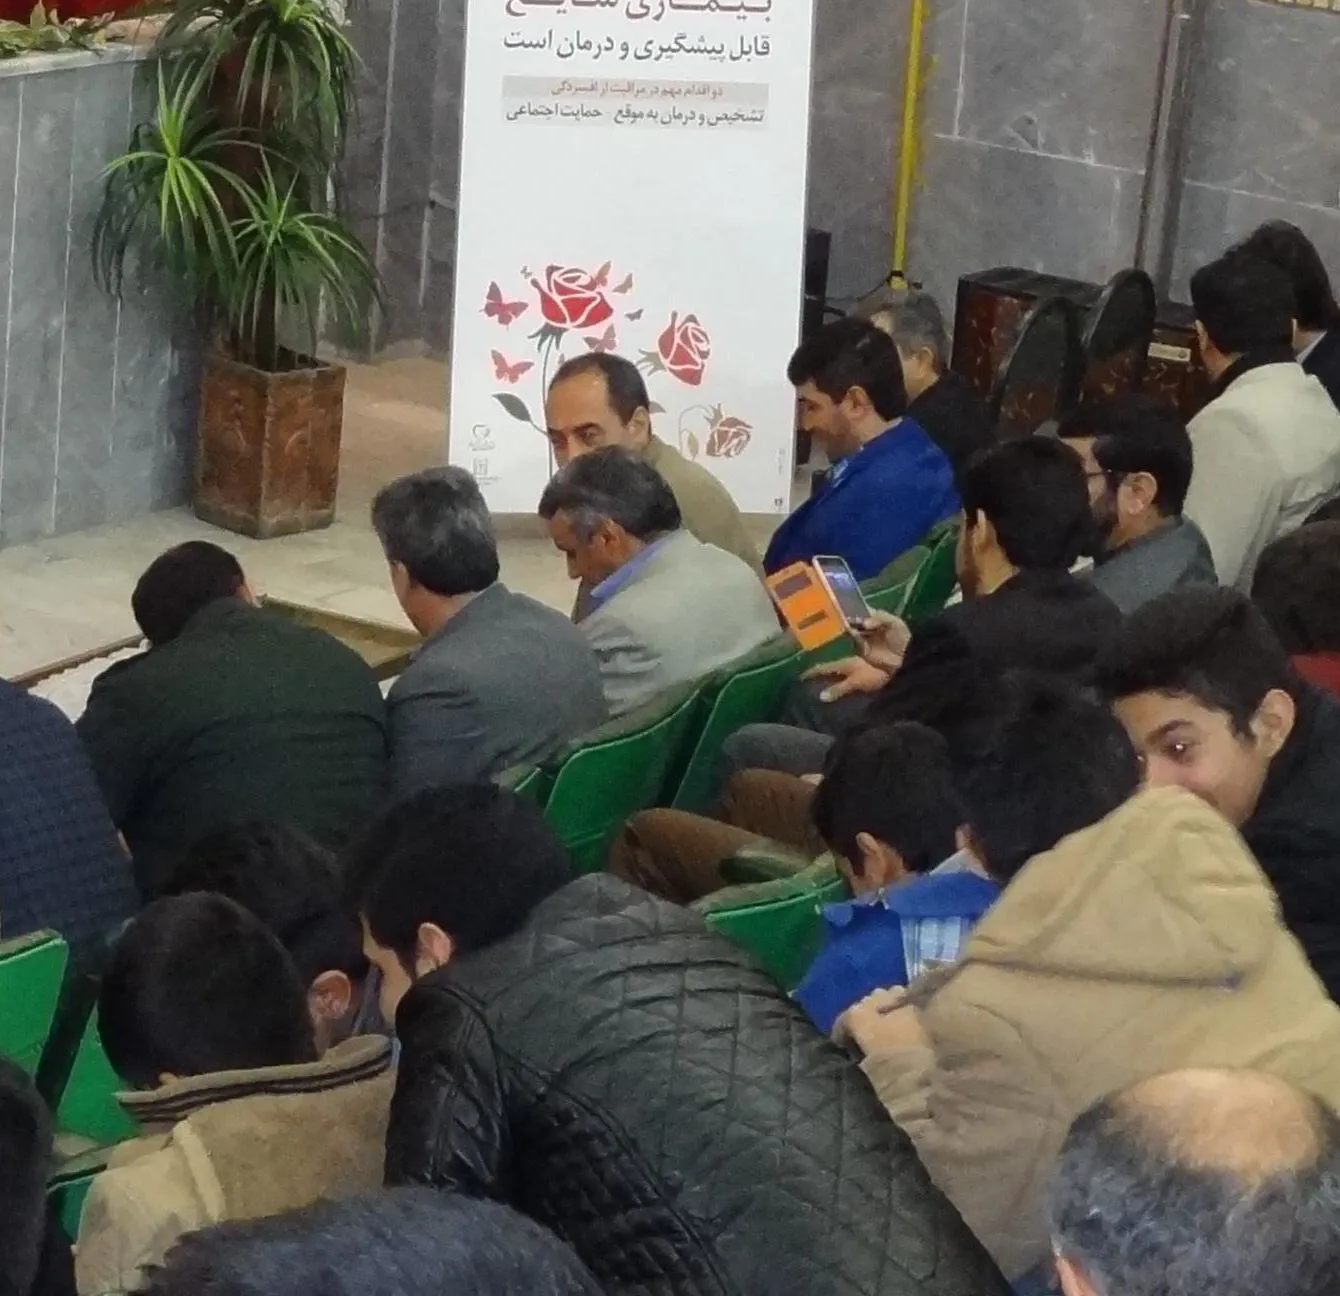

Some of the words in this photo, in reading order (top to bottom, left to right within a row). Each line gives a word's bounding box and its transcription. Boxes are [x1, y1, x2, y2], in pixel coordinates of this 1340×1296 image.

[503, 28, 554, 50] است
[556, 29, 614, 60] درمان
[633, 31, 726, 63] پیشگیری
[728, 33, 771, 62] قابل
[619, 41, 630, 61] و
[505, 101, 559, 121] اجتماعی
[560, 103, 604, 122] حمایت
[613, 103, 645, 125] موقع
[659, 105, 697, 126] درمان
[706, 107, 765, 126] تشخیص
